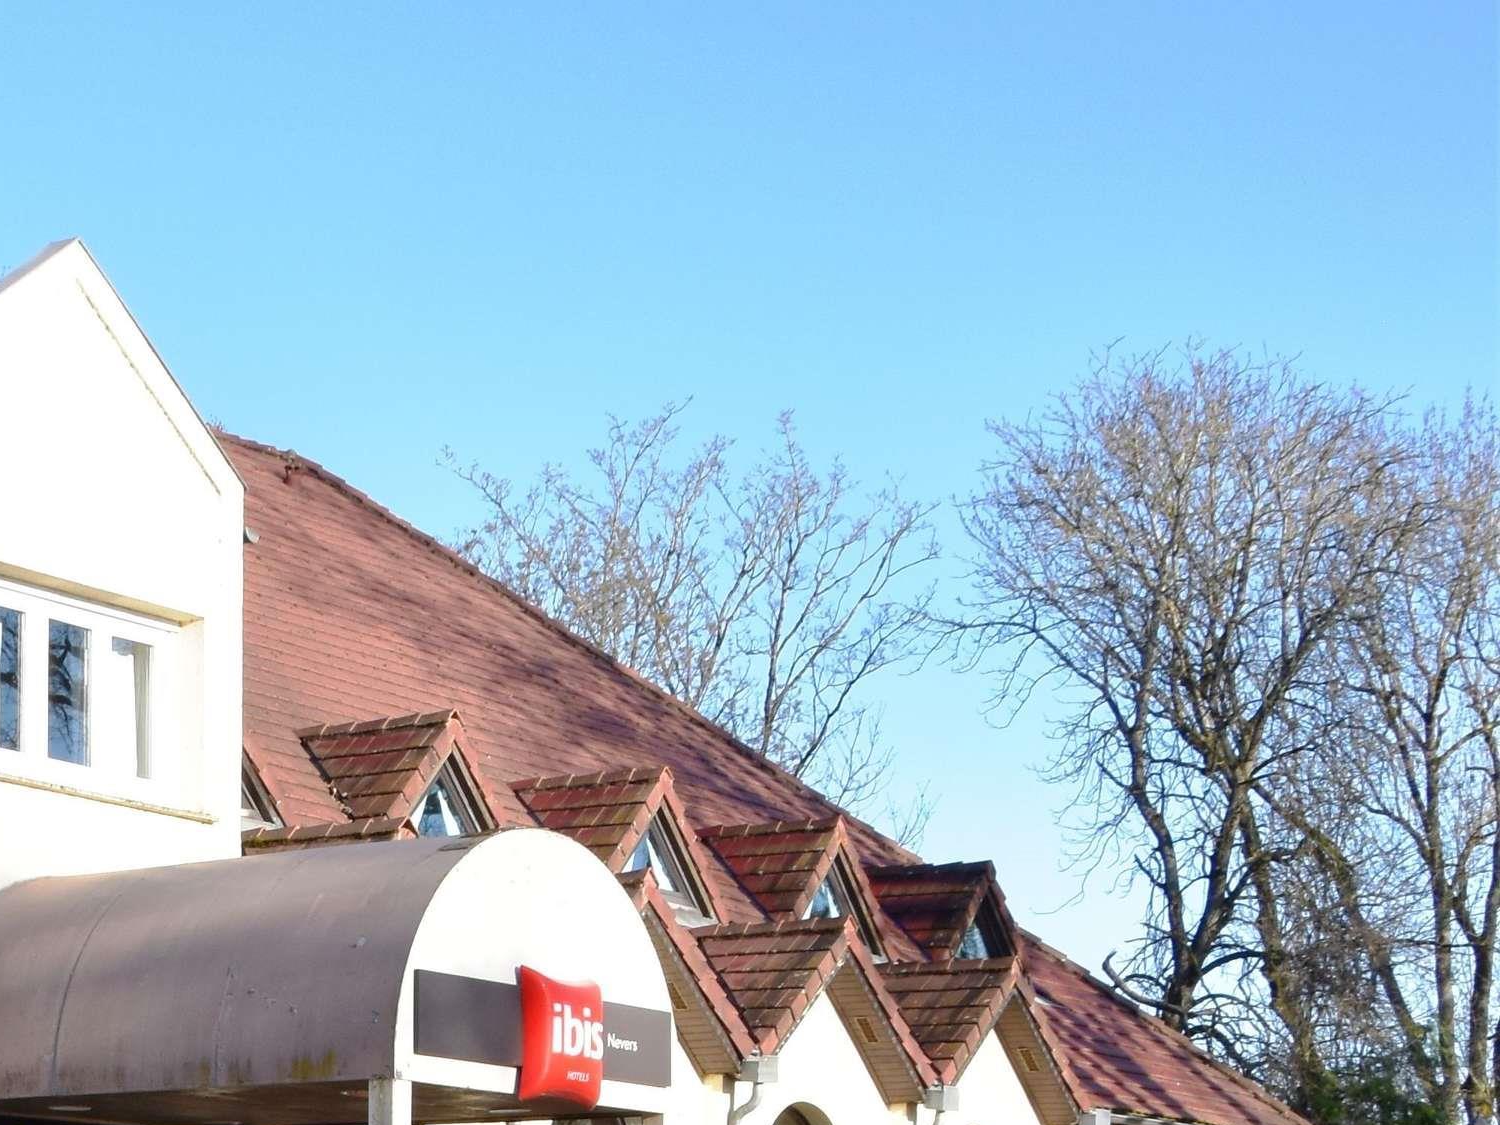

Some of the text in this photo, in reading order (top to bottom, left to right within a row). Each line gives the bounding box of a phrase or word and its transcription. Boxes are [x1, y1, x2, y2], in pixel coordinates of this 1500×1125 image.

[551, 1002, 604, 1061] ibis
[607, 1032, 638, 1052] Nevers
[566, 1071, 590, 1082] HOTELS
